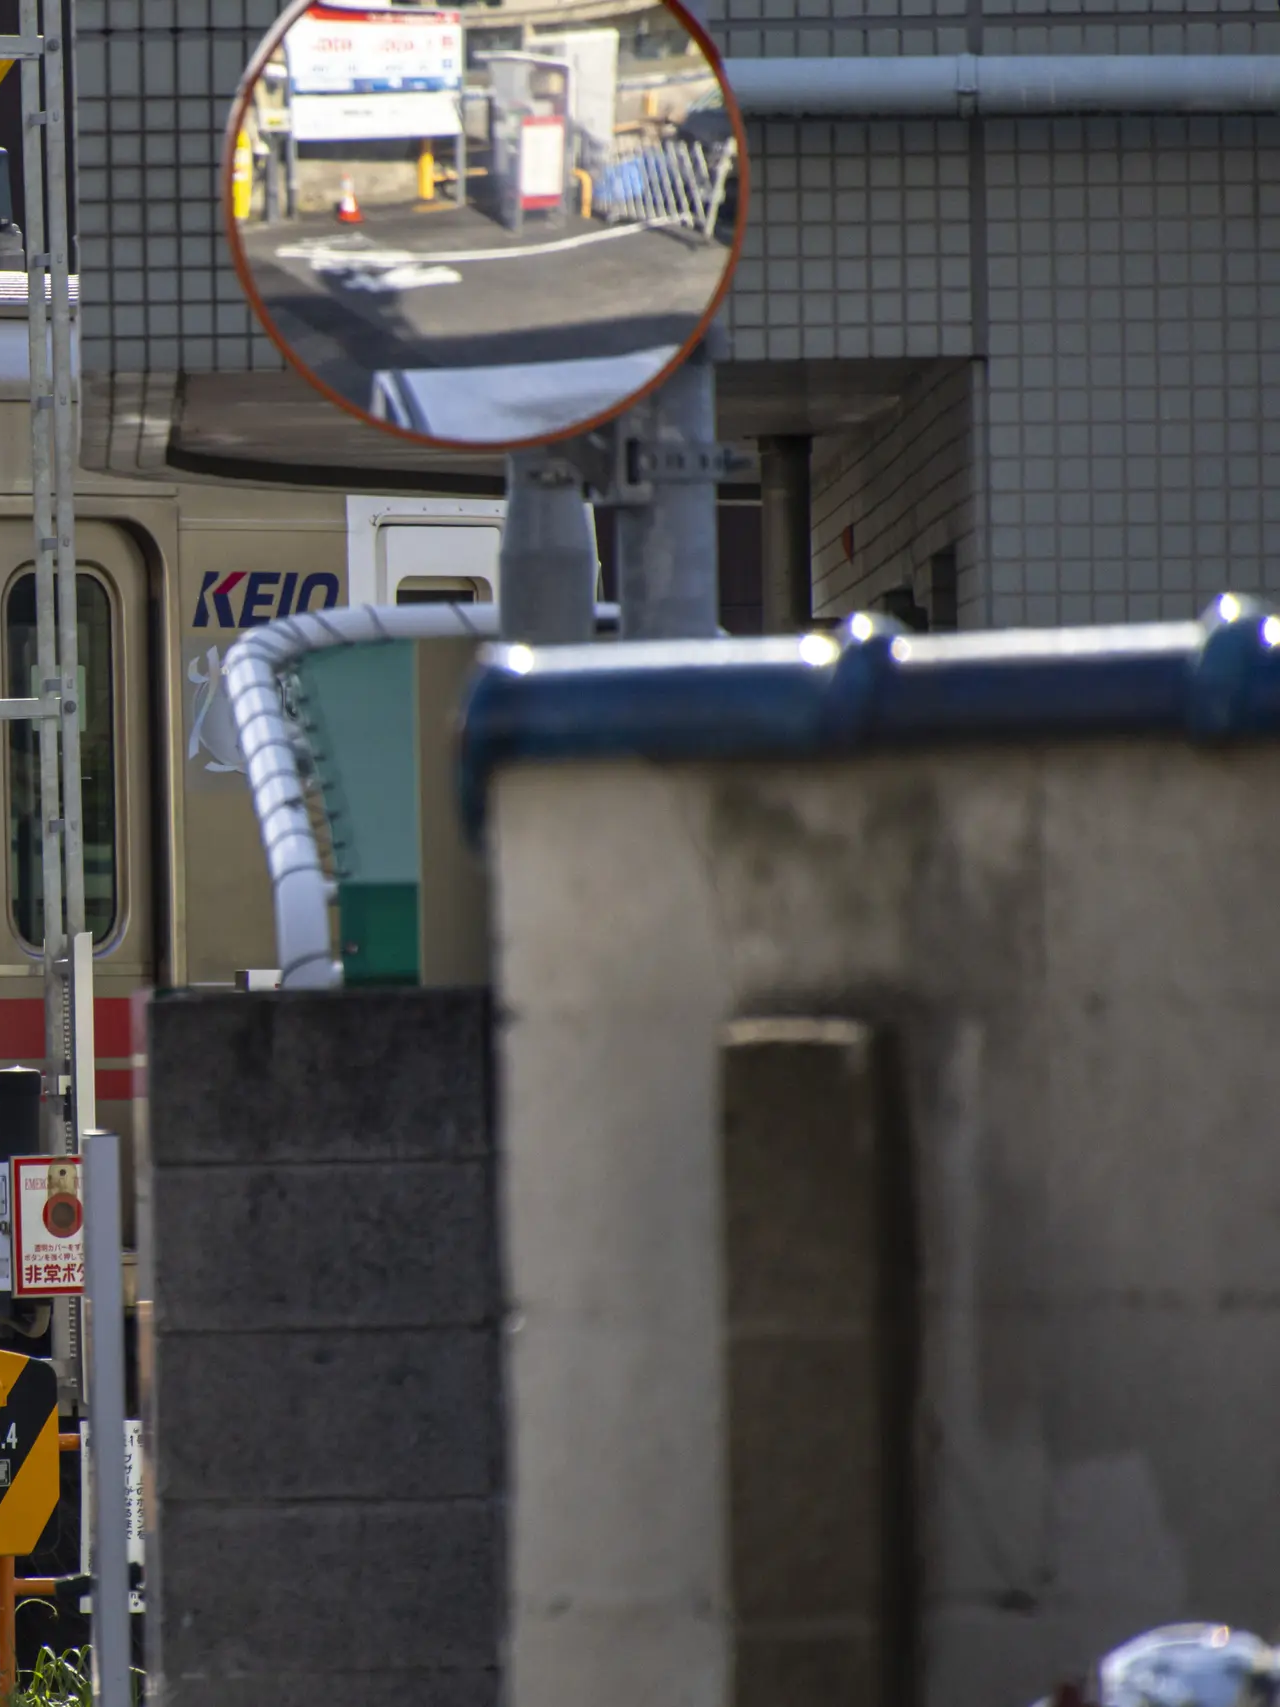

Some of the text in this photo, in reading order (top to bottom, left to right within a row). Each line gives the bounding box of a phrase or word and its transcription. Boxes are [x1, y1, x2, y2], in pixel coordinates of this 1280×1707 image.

[192, 571, 339, 628] KEIO
[34, 1243, 84, 1252] 透明カバーをず
